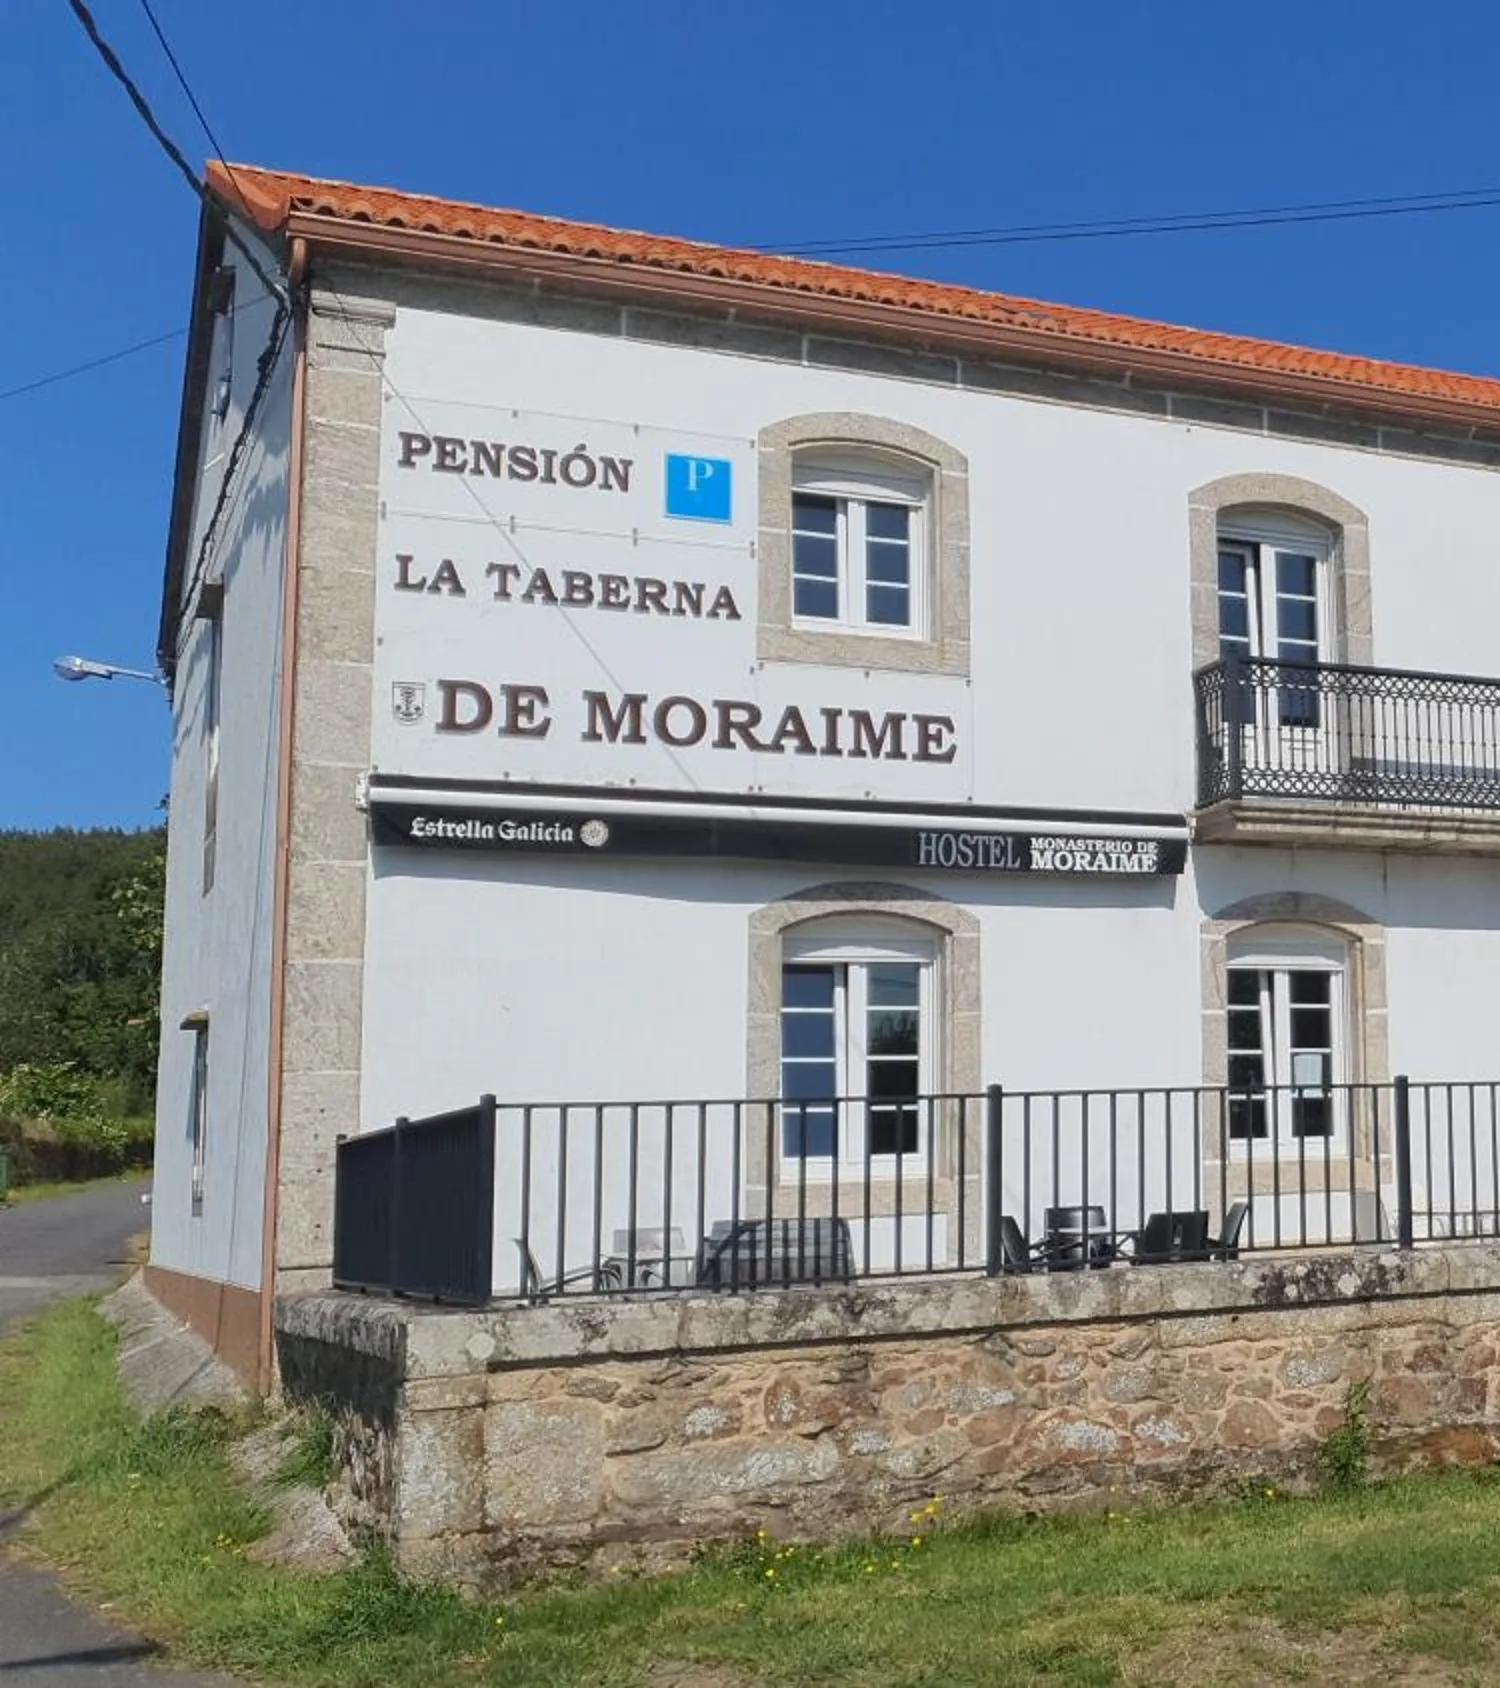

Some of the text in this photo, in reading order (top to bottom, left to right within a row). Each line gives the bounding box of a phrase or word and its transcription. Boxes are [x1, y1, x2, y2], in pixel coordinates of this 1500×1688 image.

[399, 431, 632, 492] PENSIÓN
[687, 459, 713, 491] P
[394, 554, 742, 619] LA TABERNA
[436, 679, 958, 764] DE MORAIME
[410, 817, 573, 842] Estrella Galicia
[1029, 837, 1158, 853] MONASTERIO DE
[918, 832, 1021, 869] HOSTEL
[1029, 851, 1158, 873] MORAIME
